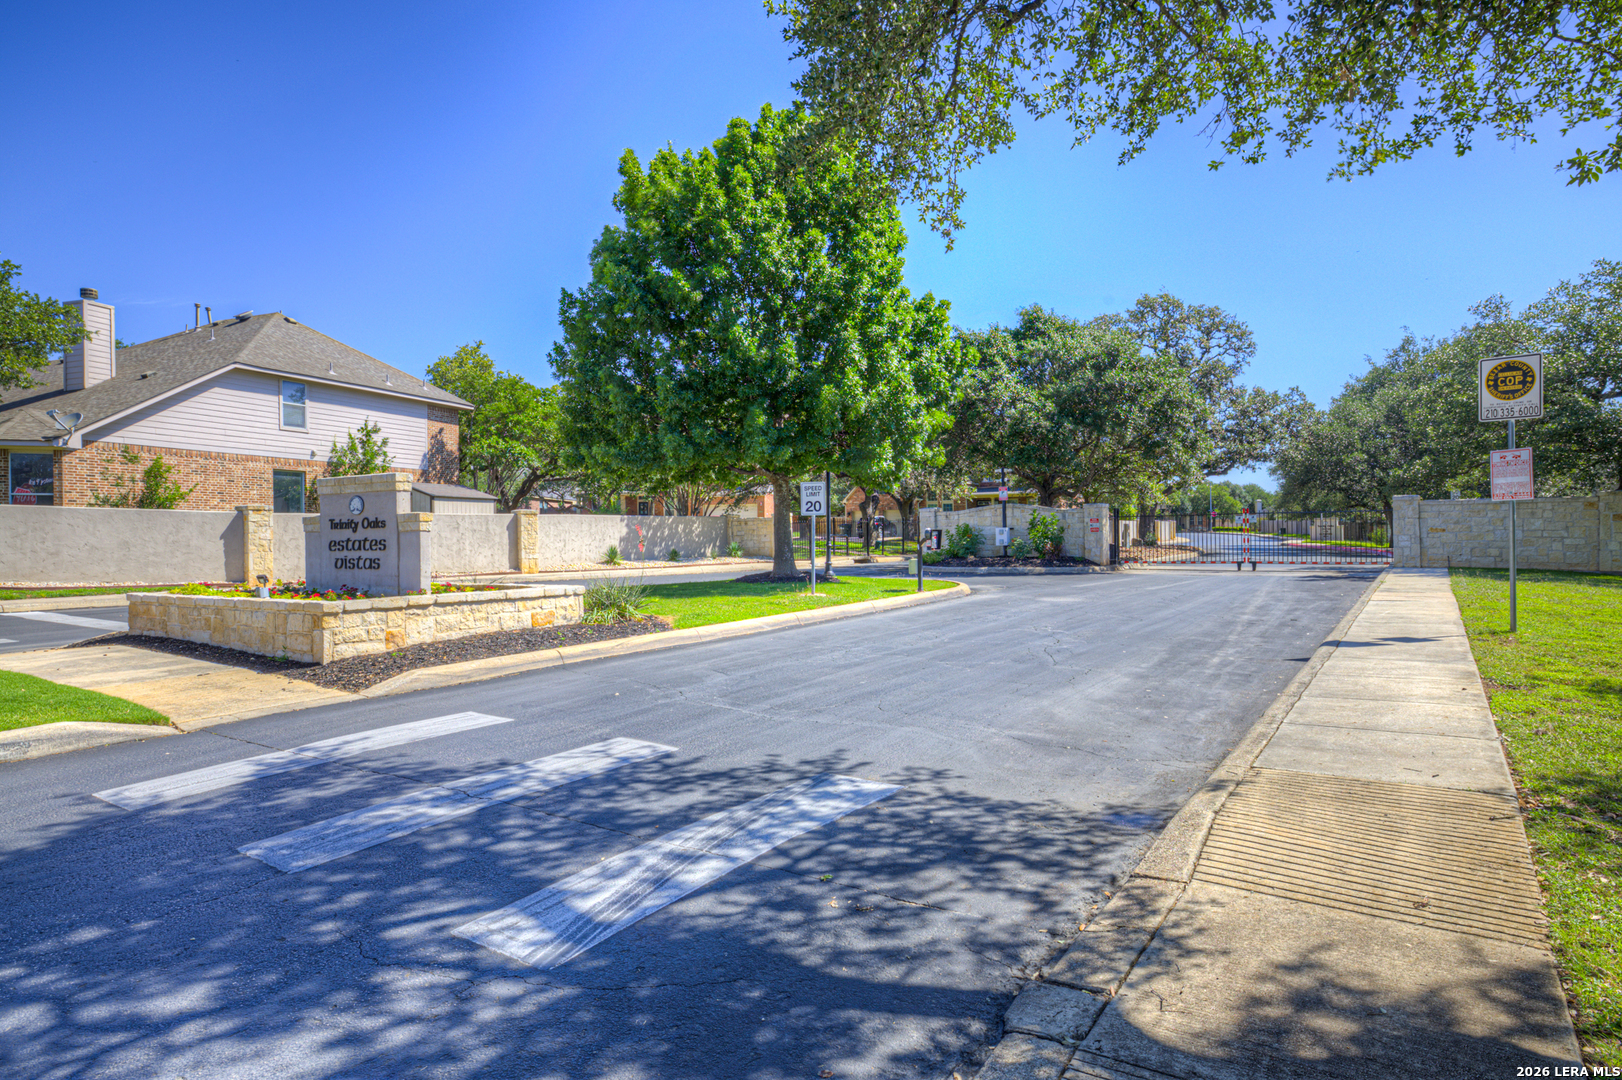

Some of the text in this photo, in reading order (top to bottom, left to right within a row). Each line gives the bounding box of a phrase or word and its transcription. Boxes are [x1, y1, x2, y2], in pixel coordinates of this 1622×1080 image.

[1510, 361, 1534, 376] COUNTY
[1497, 375, 1524, 387] COP
[1488, 386, 1514, 399] SHERIFF'S
[1514, 382, 1533, 398] OFFICE
[1485, 408, 1498, 418] 210
[805, 500, 822, 512] 20
[328, 516, 387, 534] Trinity Oaks
[328, 537, 387, 552] estates
[334, 555, 381, 570] vistas
